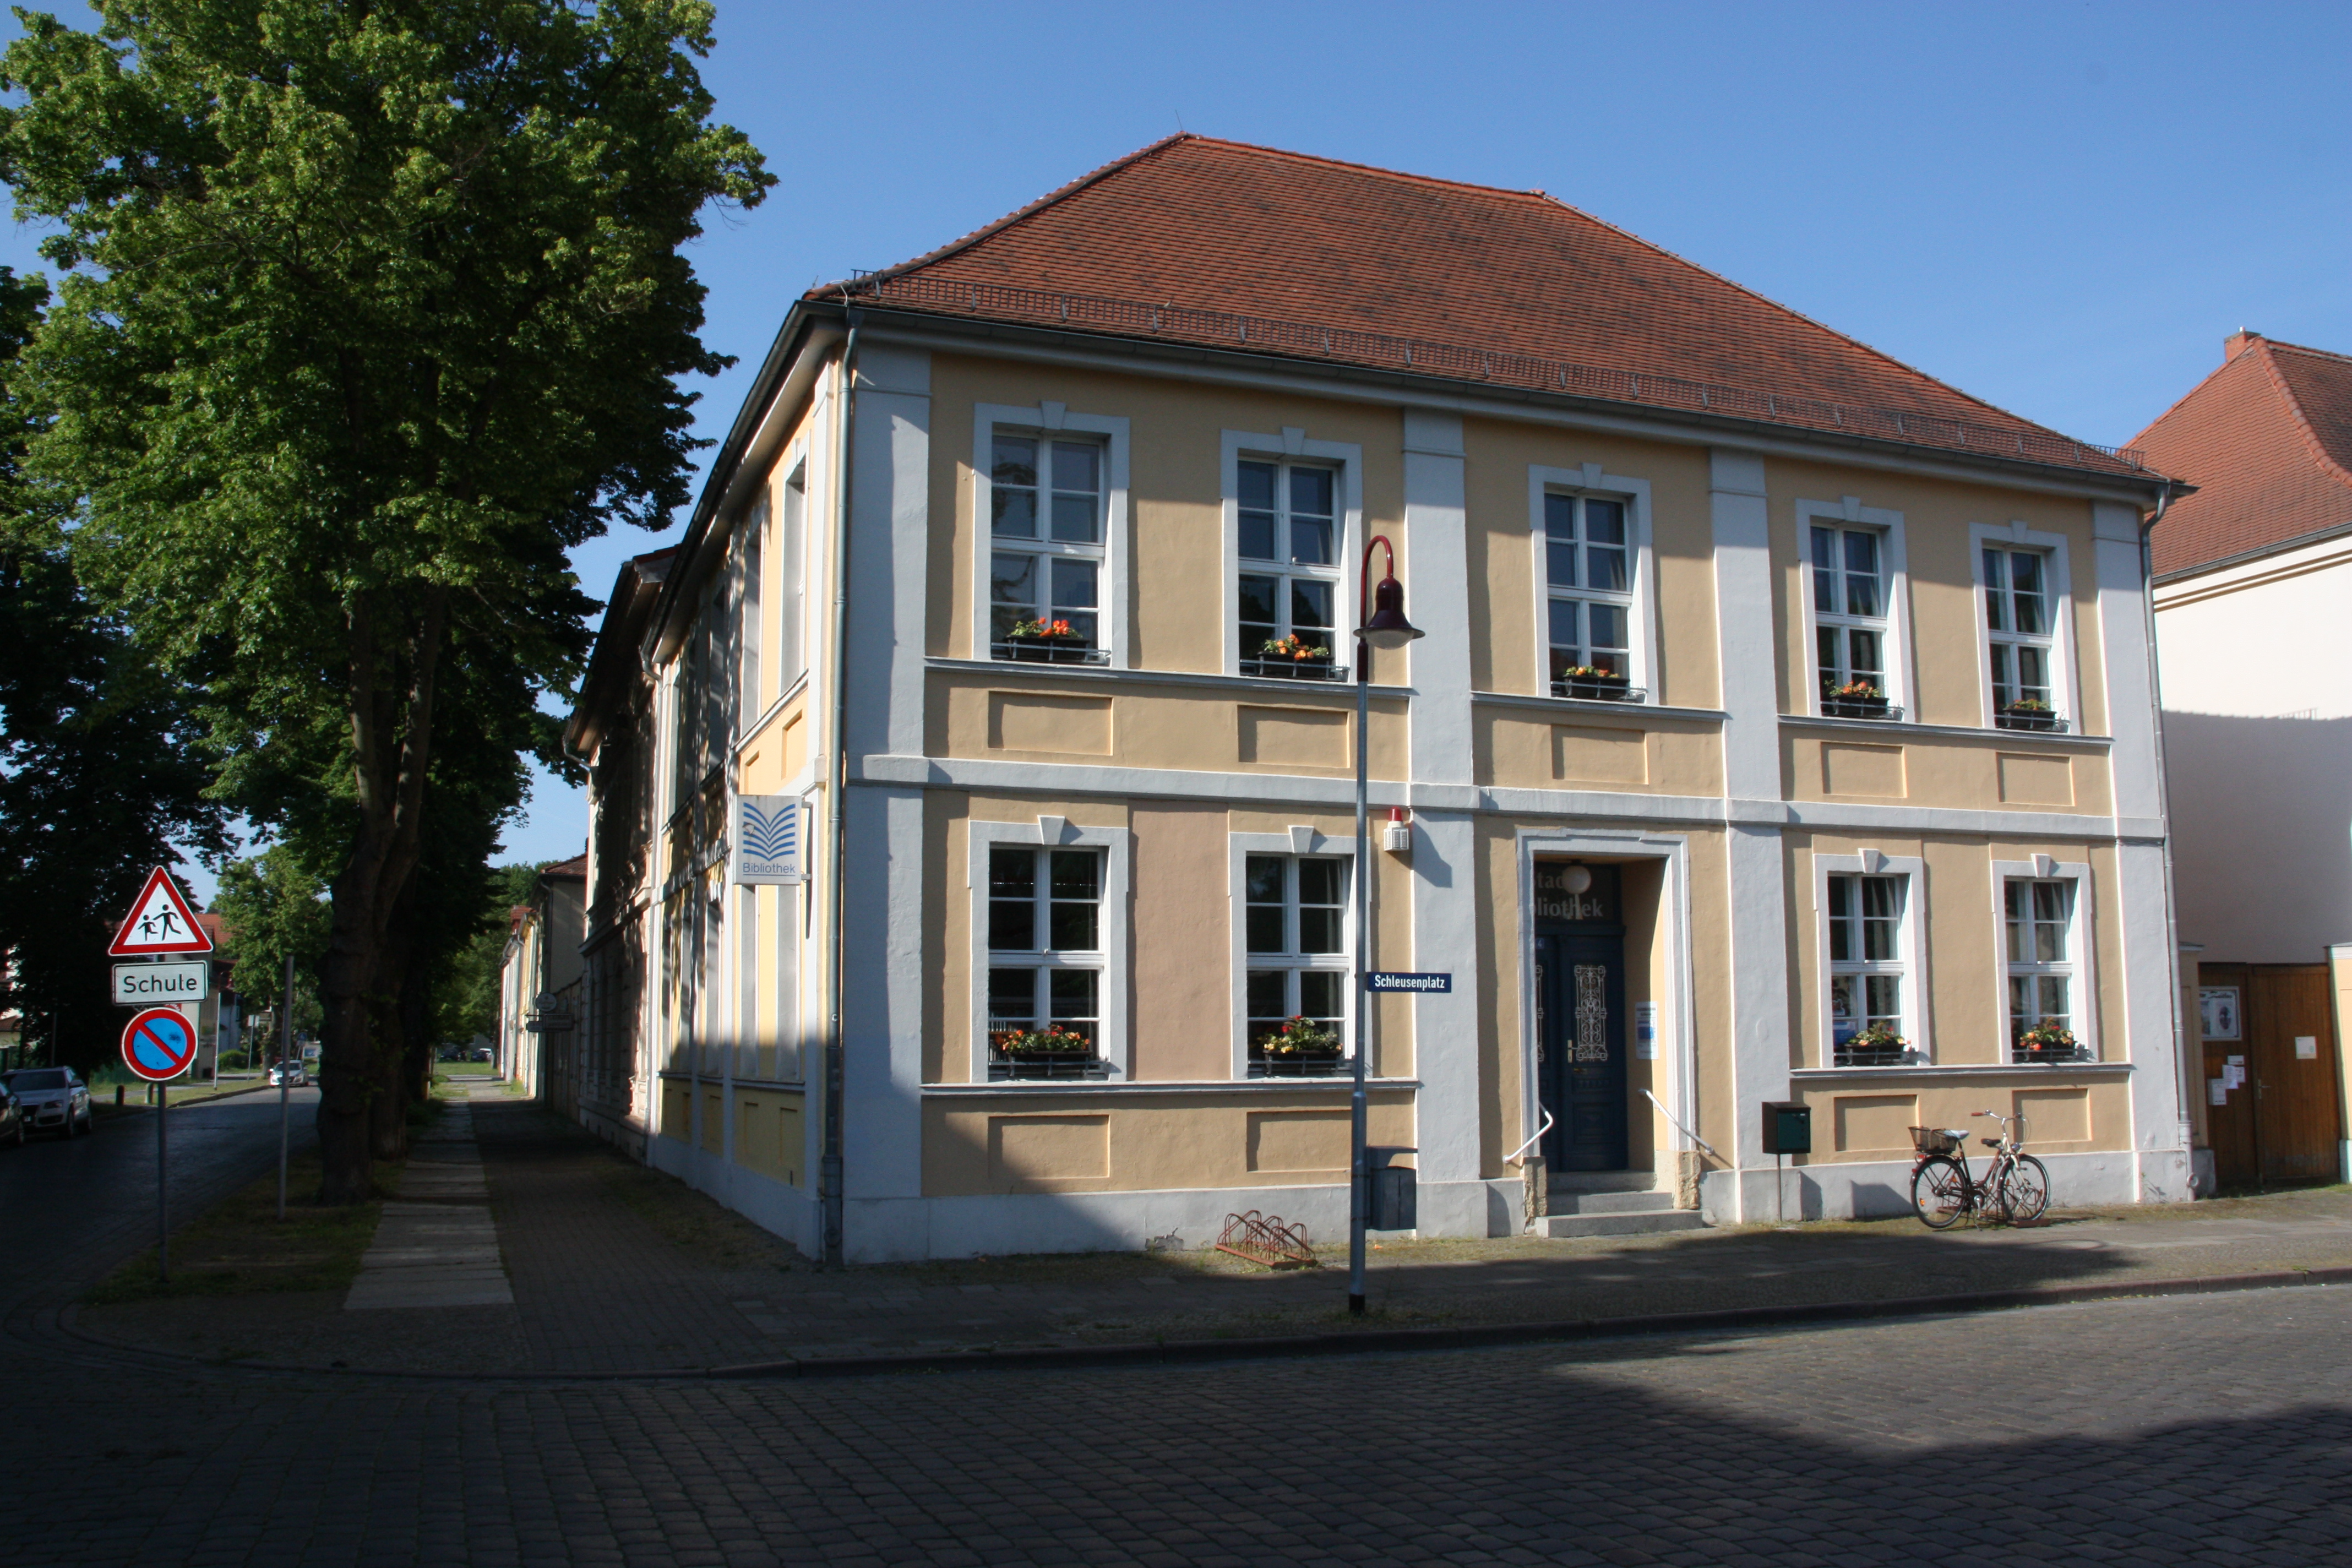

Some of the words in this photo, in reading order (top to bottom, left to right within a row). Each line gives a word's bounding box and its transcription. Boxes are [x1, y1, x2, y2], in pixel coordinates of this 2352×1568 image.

[743, 862, 796, 873] Bibliothek
[1534, 897, 1604, 917] liothek
[123, 973, 198, 993] Schule
[1375, 974, 1445, 991] Schleusenplatz
